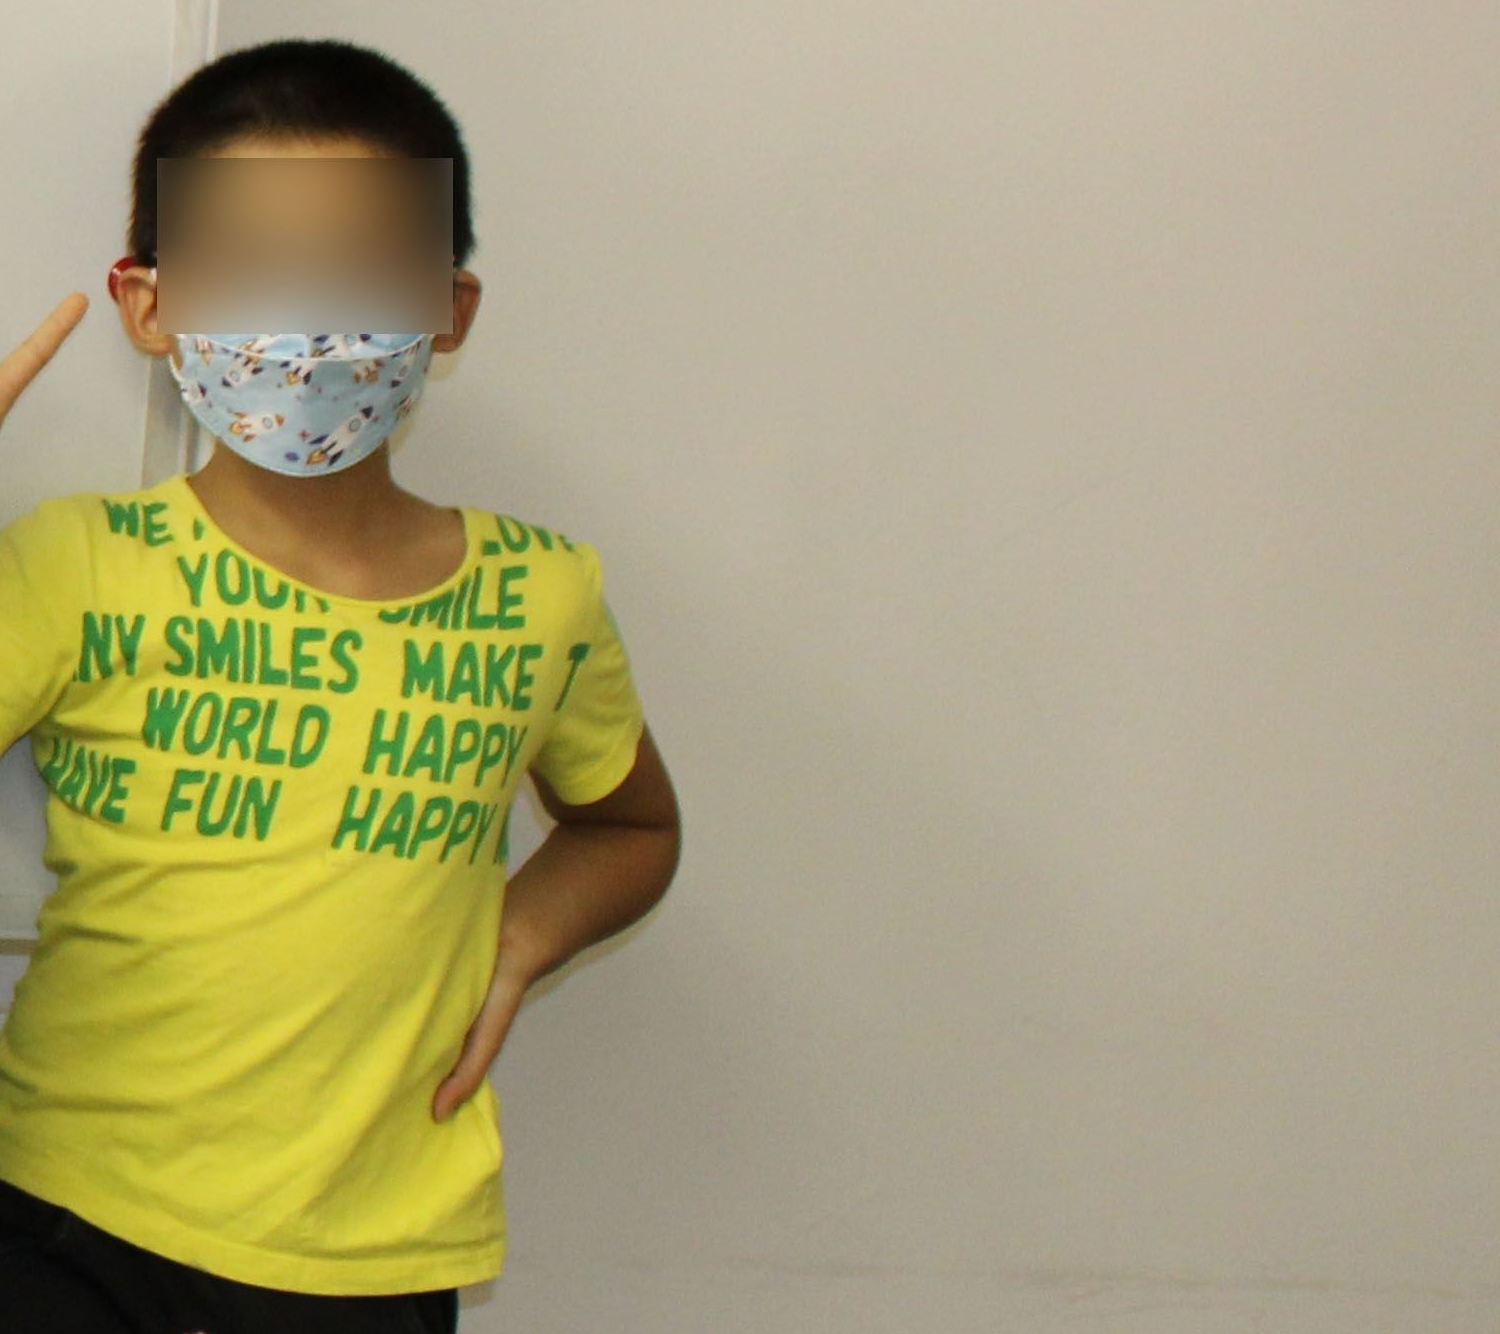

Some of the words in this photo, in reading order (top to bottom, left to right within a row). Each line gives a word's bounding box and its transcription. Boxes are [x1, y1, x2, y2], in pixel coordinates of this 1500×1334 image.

[101, 498, 175, 547] WE
[164, 615, 363, 694] SMILES
[402, 639, 543, 711] MAKE
[142, 687, 332, 769] WORLD
[362, 708, 529, 788] HAPPY
[160, 768, 283, 842] FUN
[331, 785, 498, 865] HAPPY
